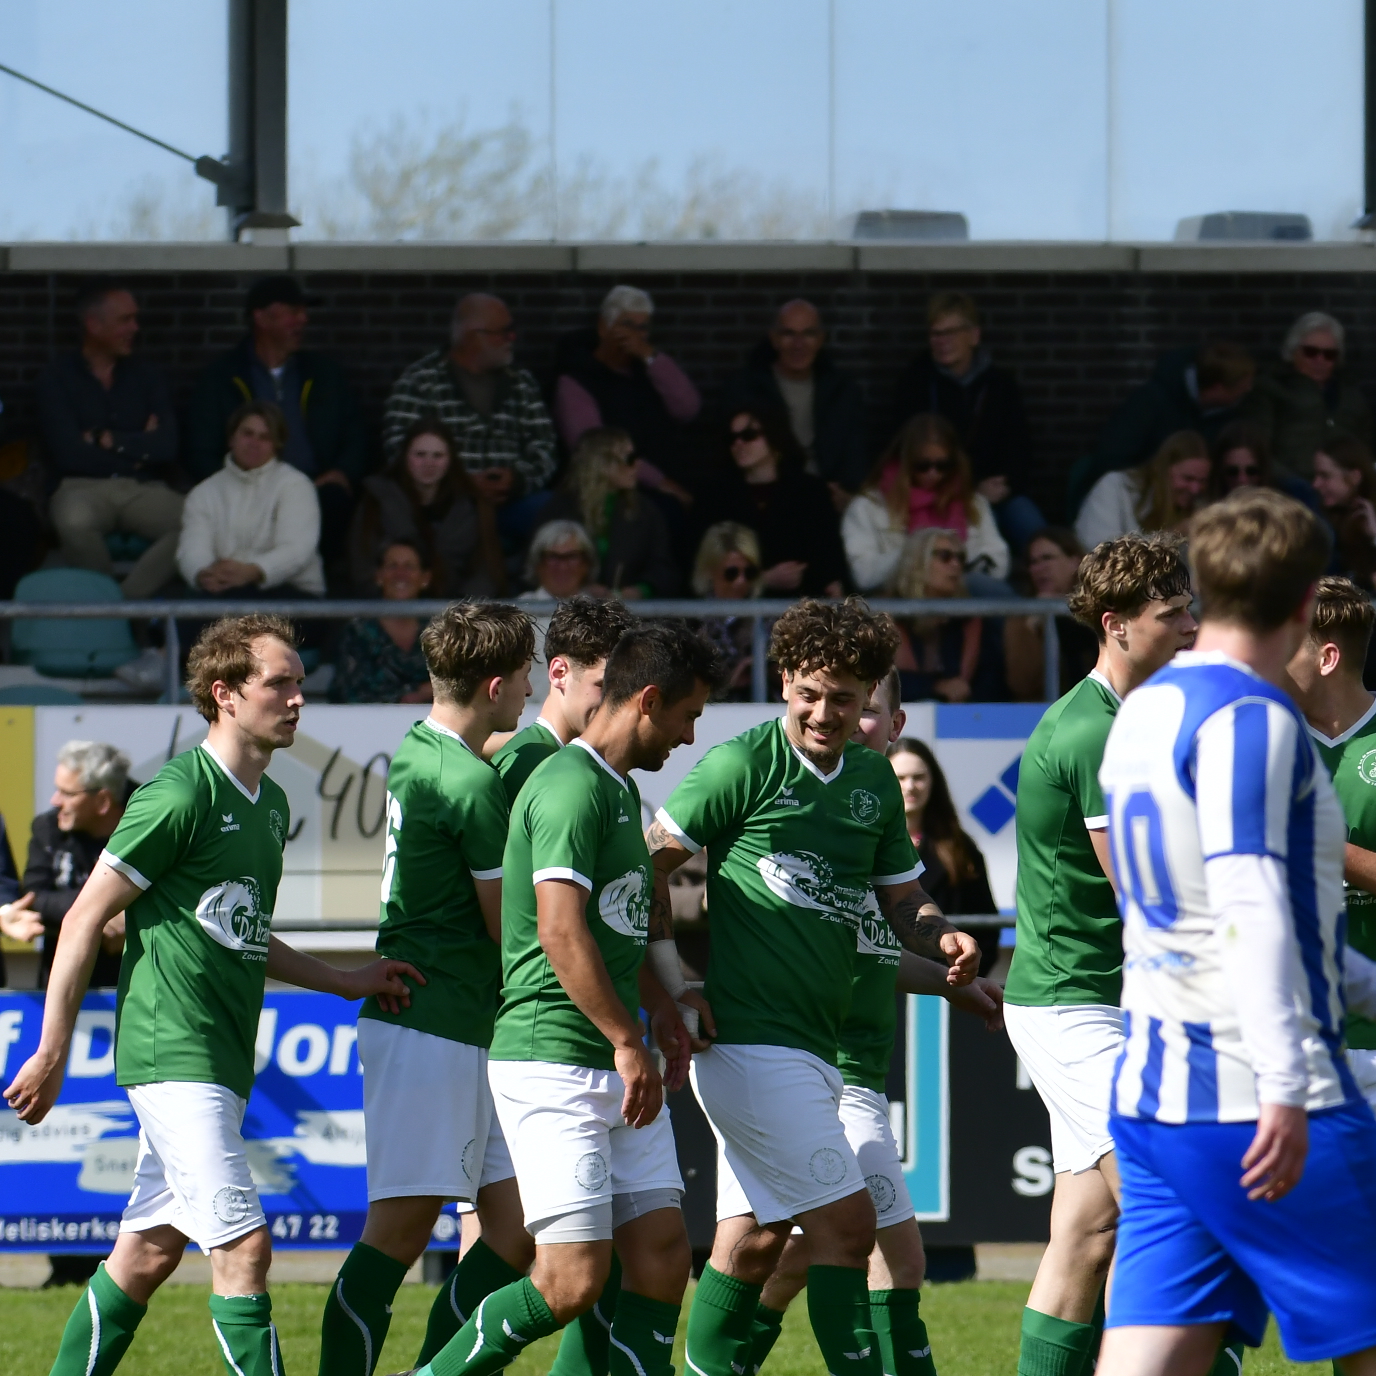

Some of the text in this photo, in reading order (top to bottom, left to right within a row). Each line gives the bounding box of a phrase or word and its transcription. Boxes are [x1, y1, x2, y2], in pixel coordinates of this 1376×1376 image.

[774, 798, 799, 807] erima
[271, 1214, 303, 1239] 47
[309, 1214, 341, 1240] 22
